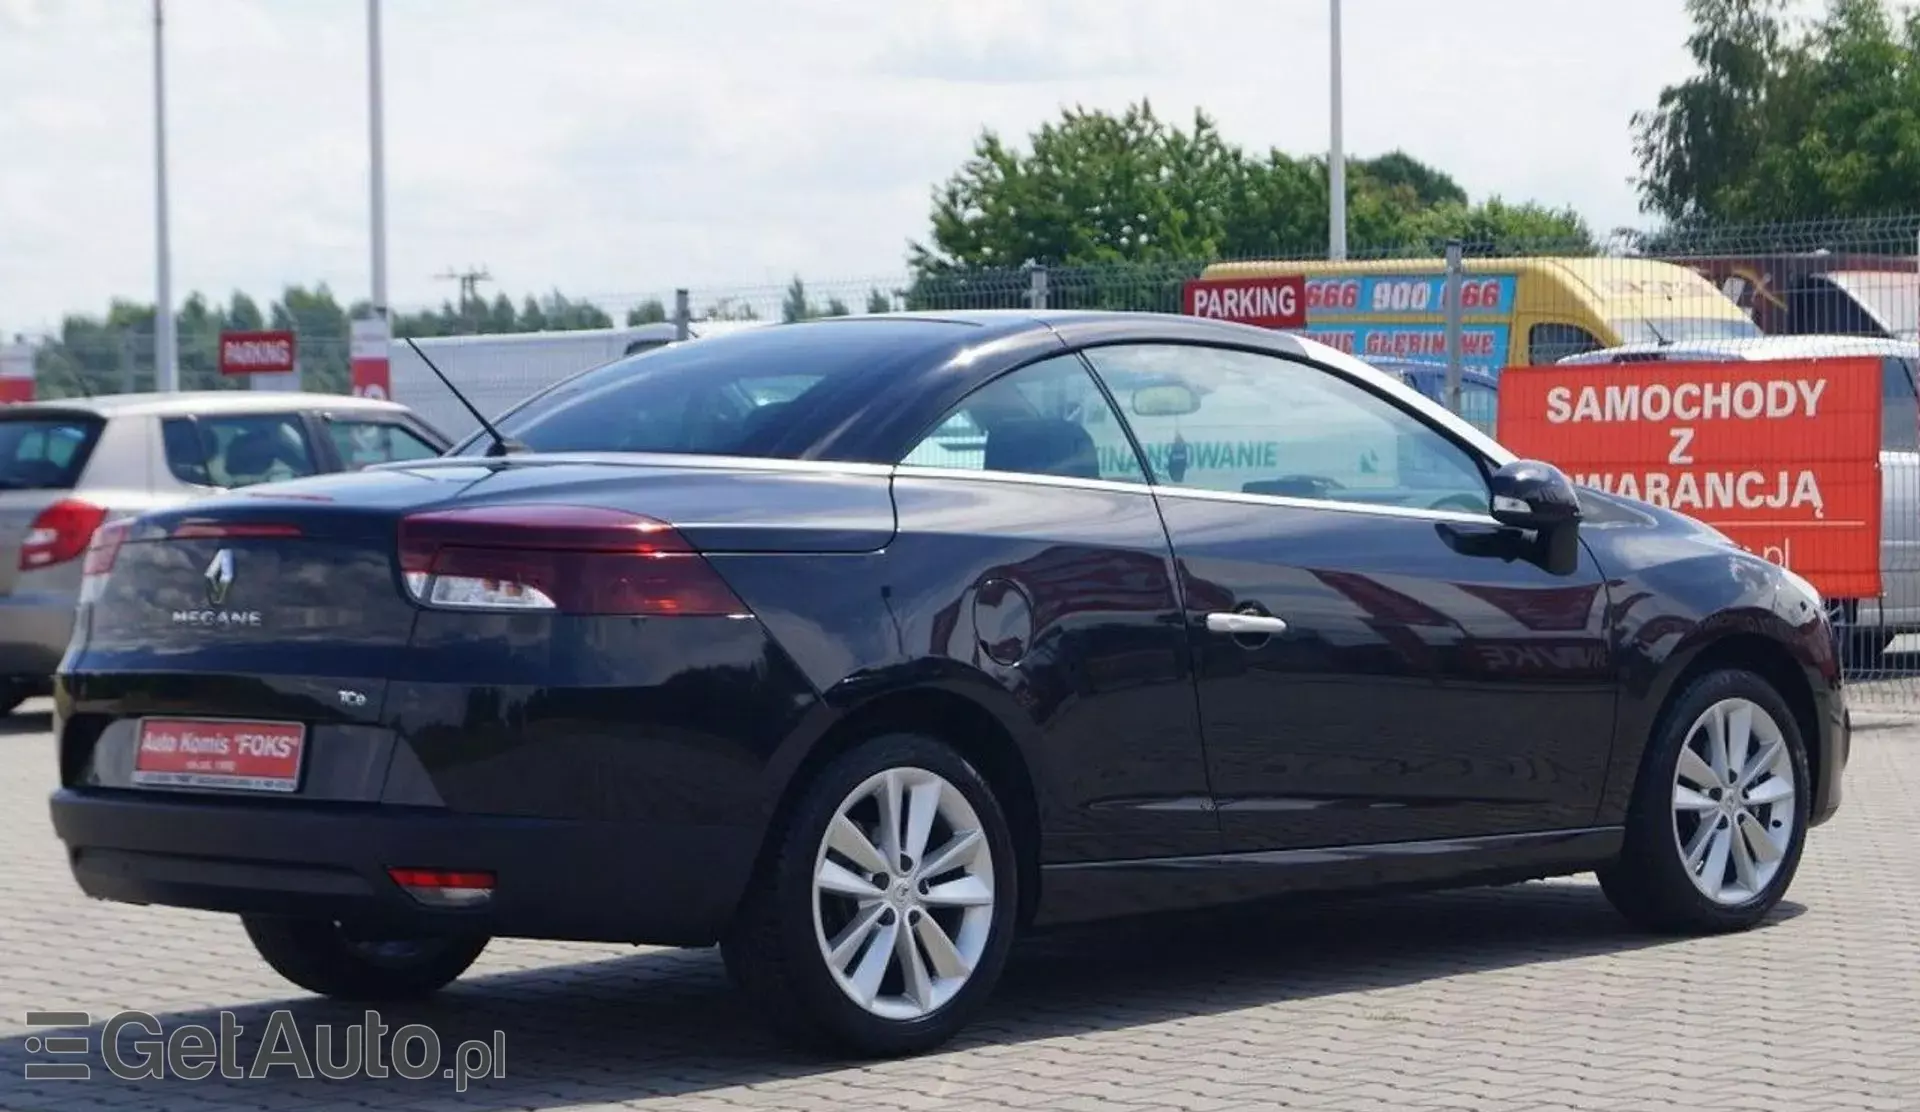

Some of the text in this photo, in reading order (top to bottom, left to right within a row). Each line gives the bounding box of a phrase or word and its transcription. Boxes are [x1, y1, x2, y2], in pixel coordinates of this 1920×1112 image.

[1193, 285, 1297, 319] PARKING
[1372, 281, 1430, 312] 900
[1440, 280, 1500, 309] 66
[224, 340, 291, 367] PARKING
[1366, 331, 1495, 358] GŁĘBINWE
[1546, 378, 1828, 424] SAMOCHODY
[1667, 427, 1695, 465] Z
[1567, 470, 1825, 519] WARANCJĄ
[172, 610, 262, 627] MEGANE
[141, 732, 177, 752] Auto
[180, 733, 230, 755] Komis
